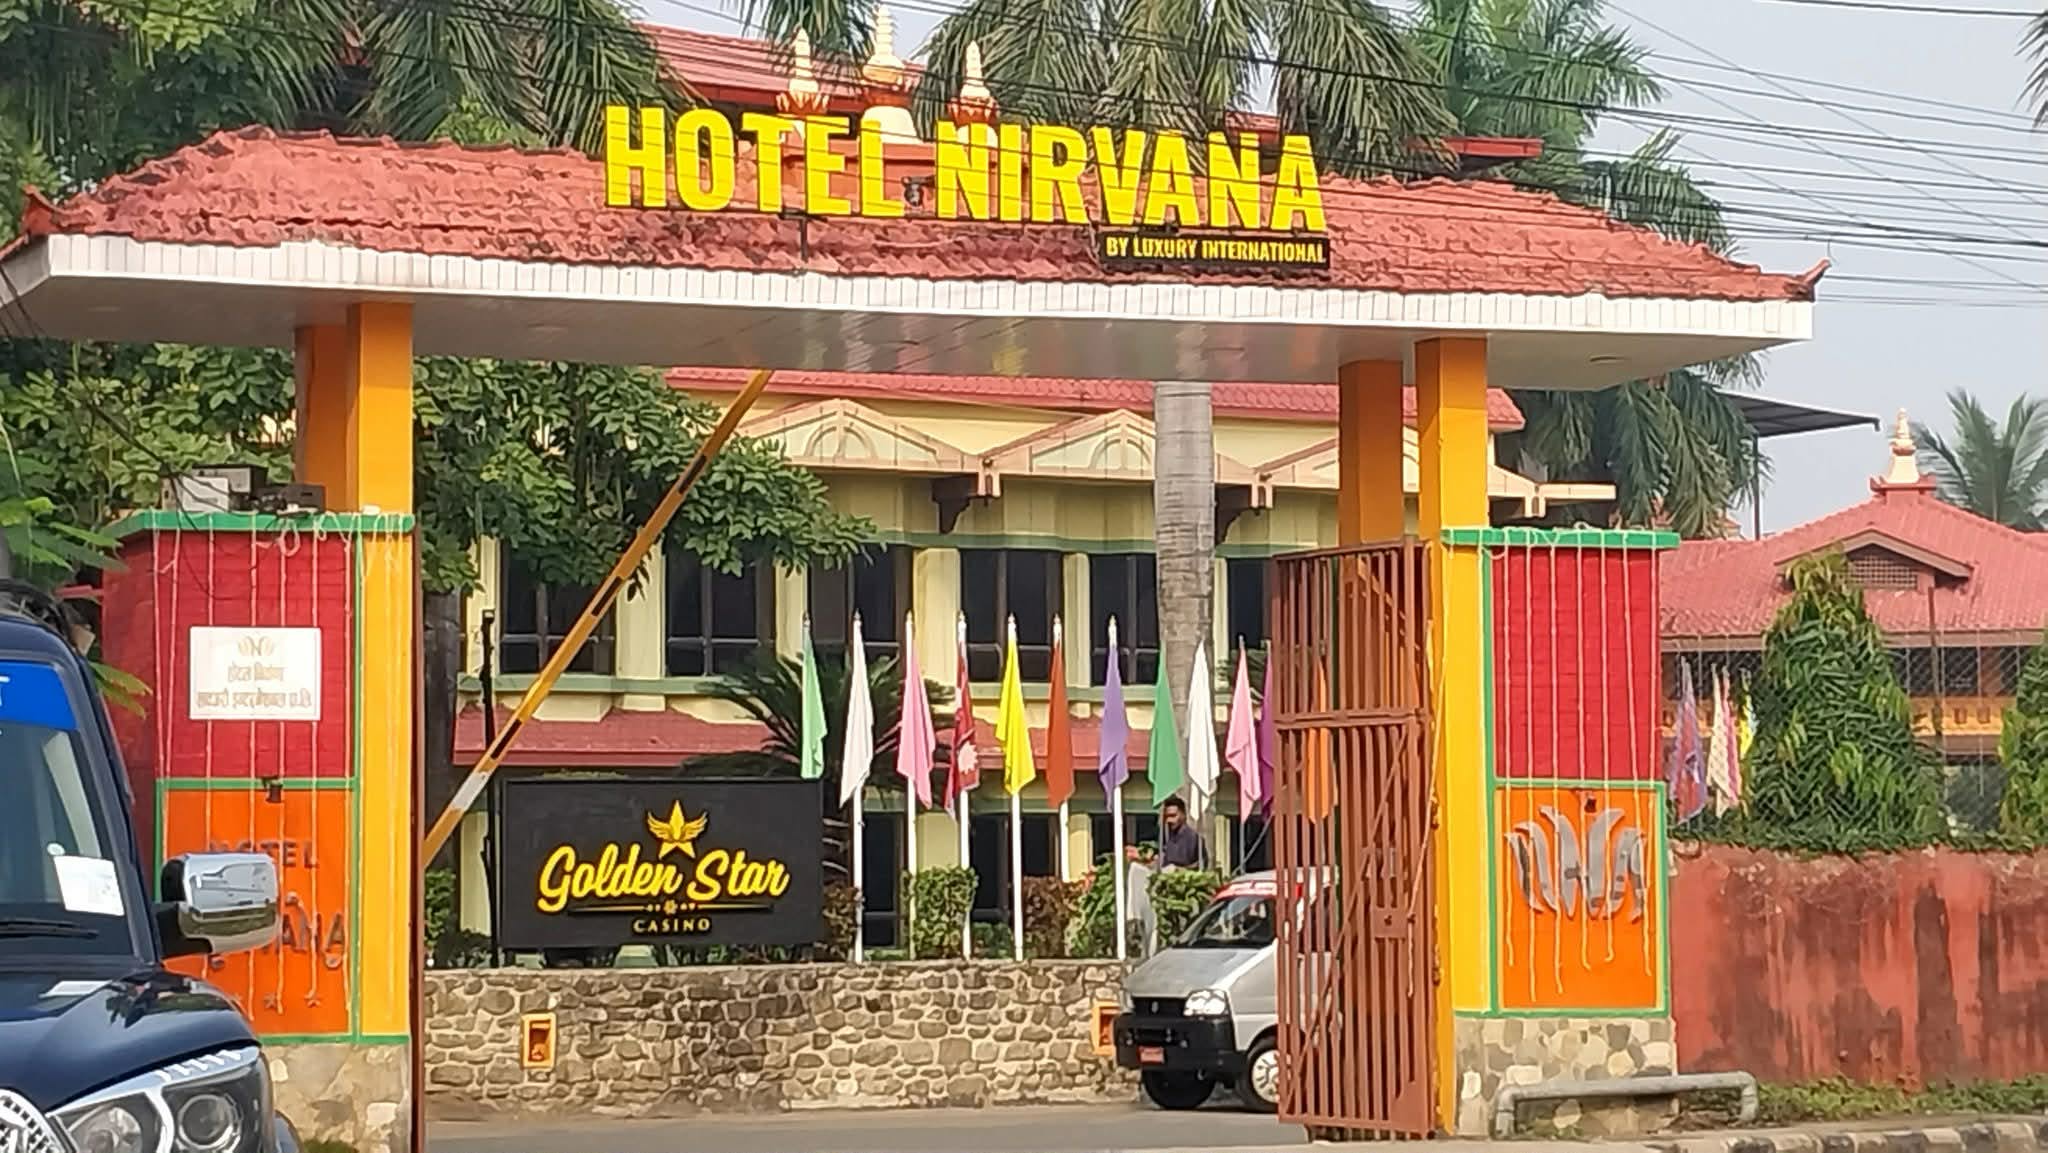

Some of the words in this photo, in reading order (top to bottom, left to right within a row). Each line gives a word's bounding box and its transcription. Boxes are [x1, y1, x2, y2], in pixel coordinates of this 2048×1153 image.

[605, 105, 905, 218] HOTEL
[935, 121, 1327, 232] NIRVANA
[1106, 236, 1129, 257] BY
[1133, 236, 1197, 259] LUXURY
[1202, 239, 1326, 263] INTERNATIONAL
[537, 843, 683, 912] Golden
[686, 849, 790, 901] Star
[632, 917, 711, 934] CASINO
